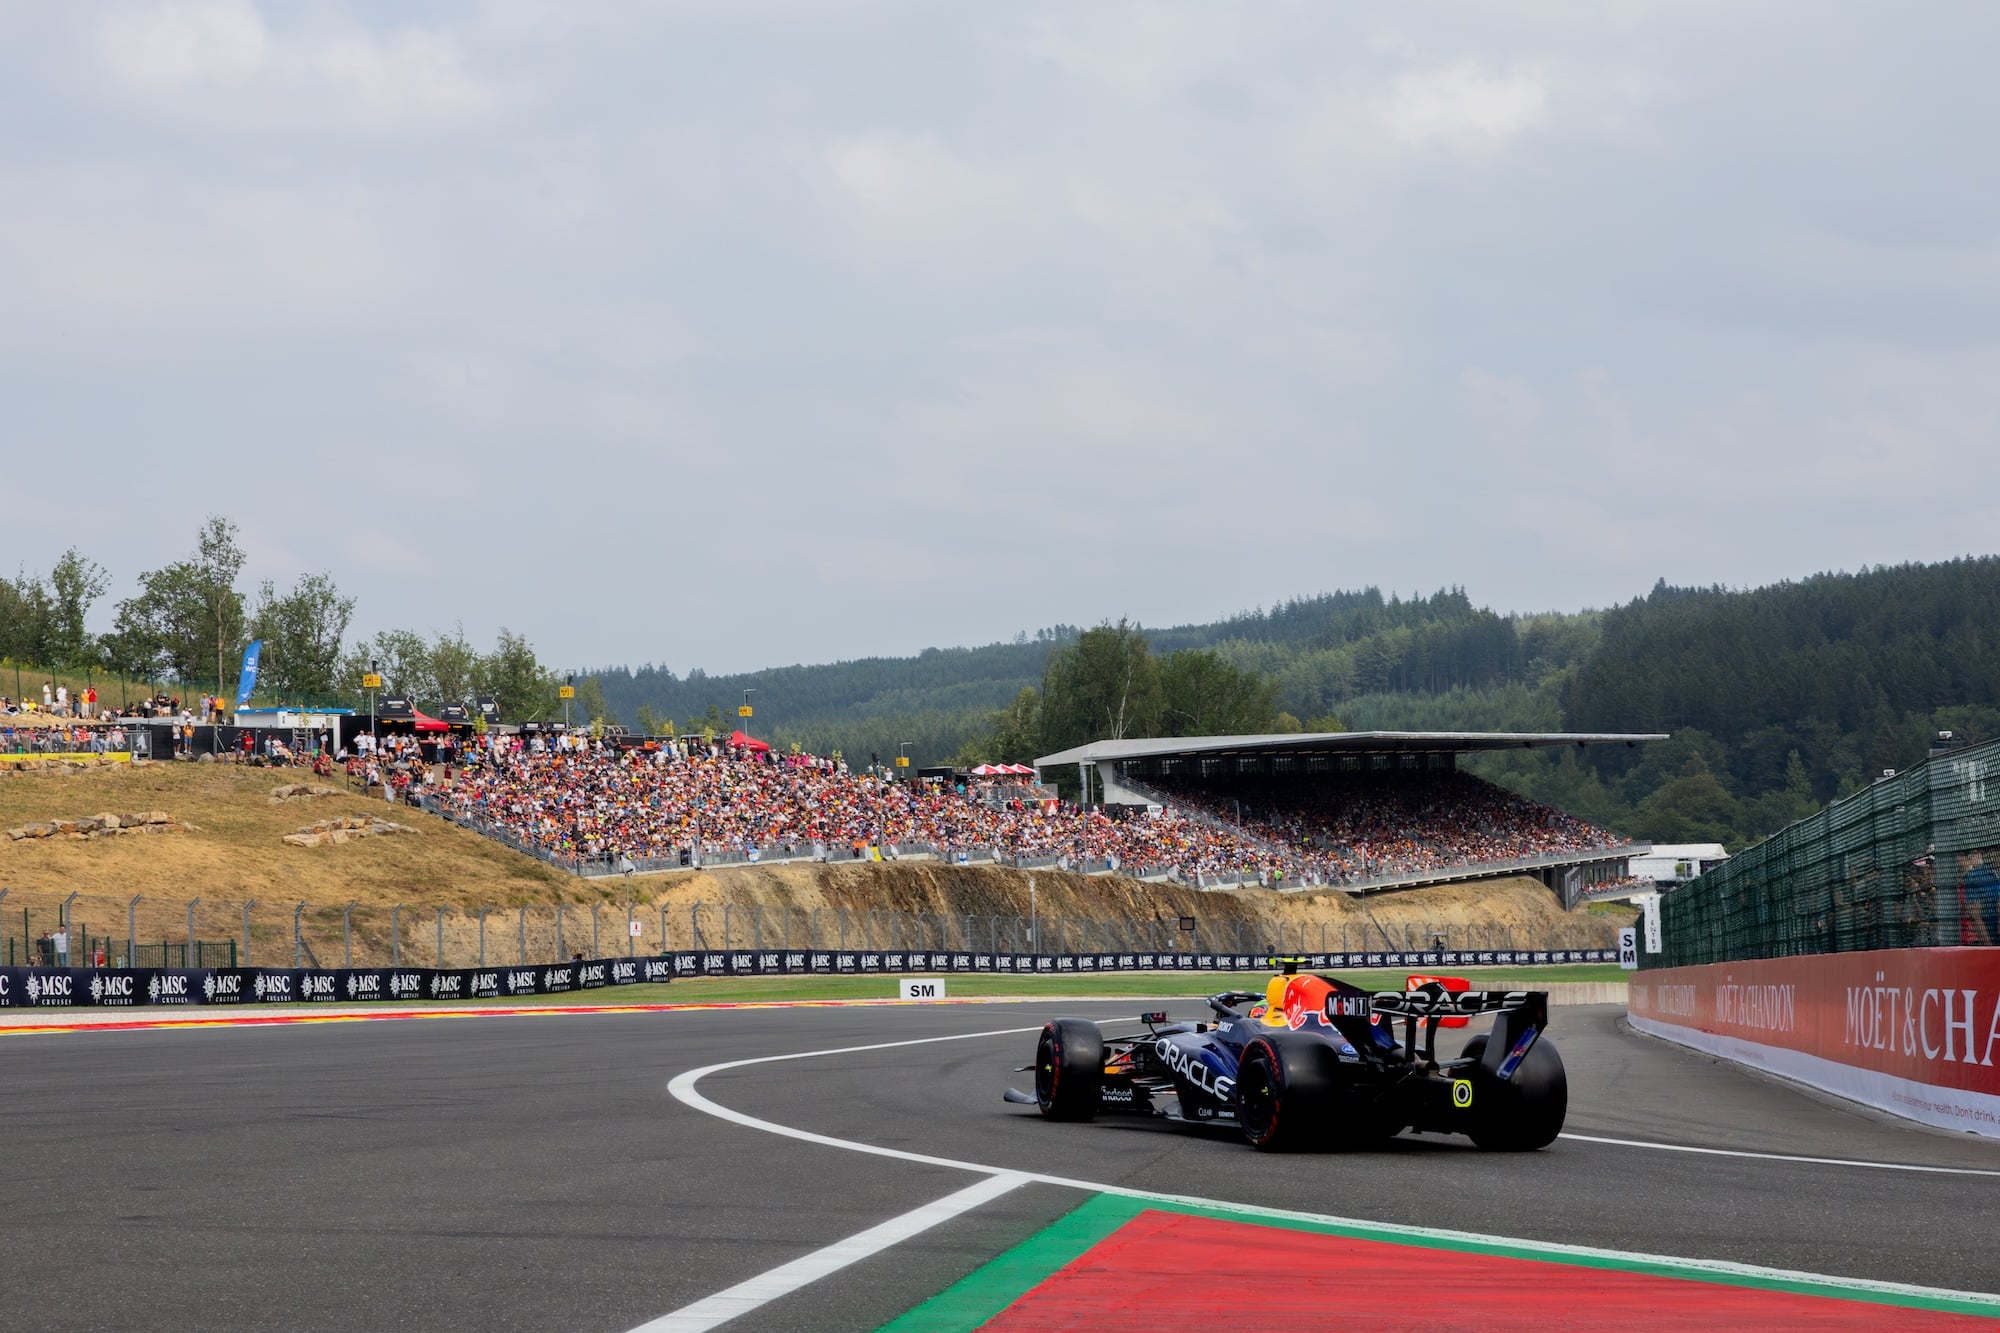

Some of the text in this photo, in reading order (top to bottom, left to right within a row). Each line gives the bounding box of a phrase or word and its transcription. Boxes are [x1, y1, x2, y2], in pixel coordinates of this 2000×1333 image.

[620, 963, 636, 977] MSC
[652, 962, 669, 975] MSC
[682, 956, 696, 968] MSC
[517, 972, 536, 986] MSC
[553, 969, 571, 984] MSC
[587, 965, 604, 980] MSC
[41, 976, 72, 995] MSC
[105, 976, 133, 995] MSC
[161, 976, 187, 994] MSC
[216, 975, 241, 993] MSC
[265, 975, 290, 992] MSC
[314, 976, 335, 992] MSC
[358, 975, 380, 991] MSC
[400, 975, 420, 990] MSC
[440, 976, 461, 991] MSC
[480, 974, 498, 989] MSC
[910, 985, 935, 997] SM
[1328, 996, 1355, 1016] Mobil
[1372, 992, 1527, 1013] ORACLE
[1746, 983, 1795, 1032] CHANDON
[1845, 971, 1900, 1052] MOËT
[1155, 1038, 1236, 1101] ORACLE
[1975, 1108, 1996, 1123] drink
